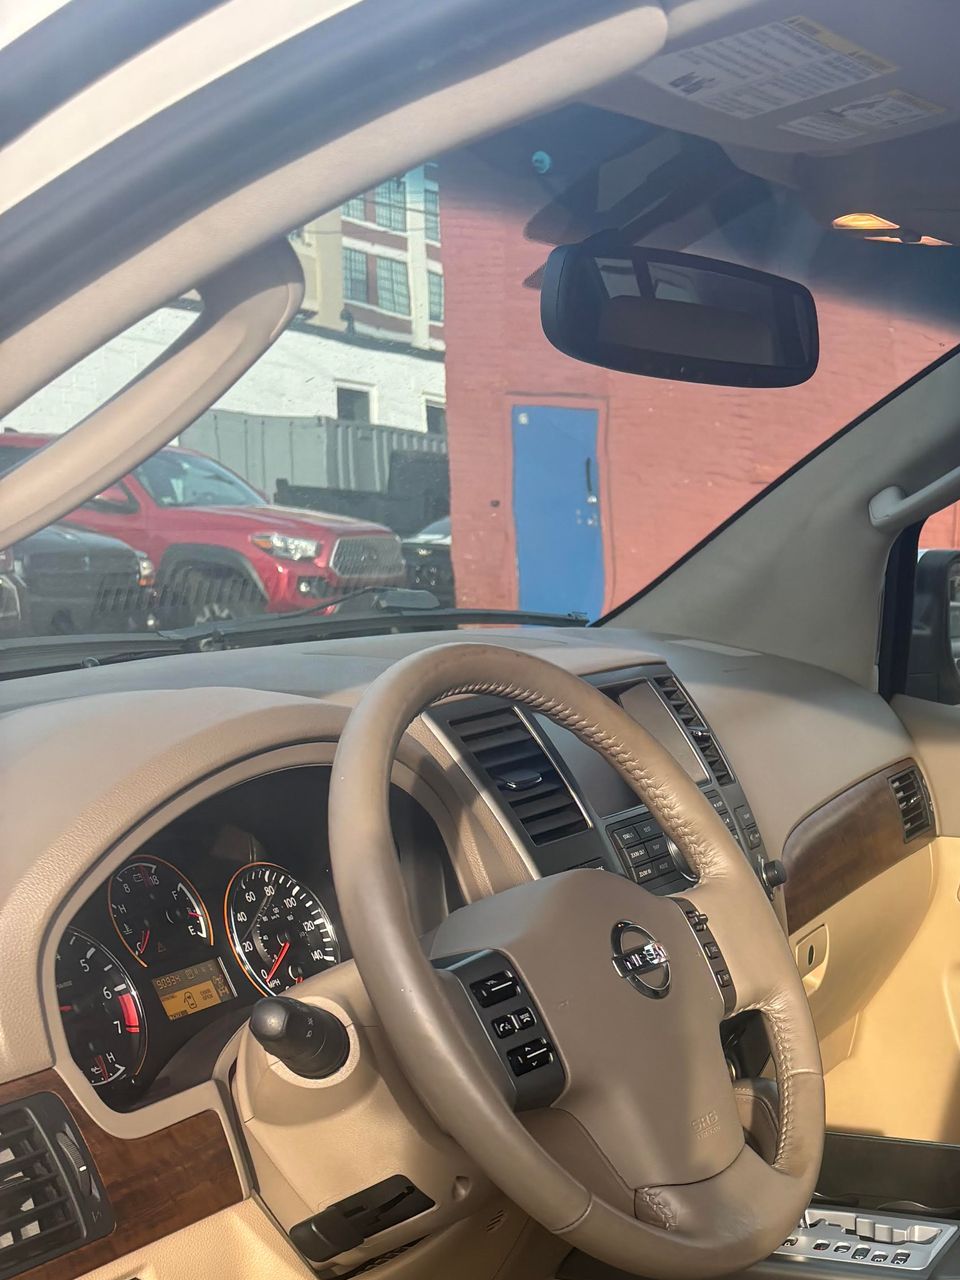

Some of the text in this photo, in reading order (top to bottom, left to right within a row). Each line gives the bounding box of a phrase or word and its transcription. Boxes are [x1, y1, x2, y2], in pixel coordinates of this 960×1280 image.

[123, 883, 131, 894] 8
[171, 889, 179, 900] F
[263, 885, 275, 897] 80
[245, 891, 256, 903] 60
[283, 896, 297, 909] 100
[117, 903, 127, 914] H
[237, 911, 248, 923] 40
[187, 925, 197, 936] E
[302, 920, 315, 932] 120
[242, 940, 254, 952] 20
[310, 949, 324, 961] 140
[80, 959, 90, 972] 5
[260, 969, 268, 979] 0
[267, 977, 281, 989] MPH
[103, 986, 112, 1000] 6
[113, 1020, 122, 1034] 7
[106, 1052, 116, 1062] H
